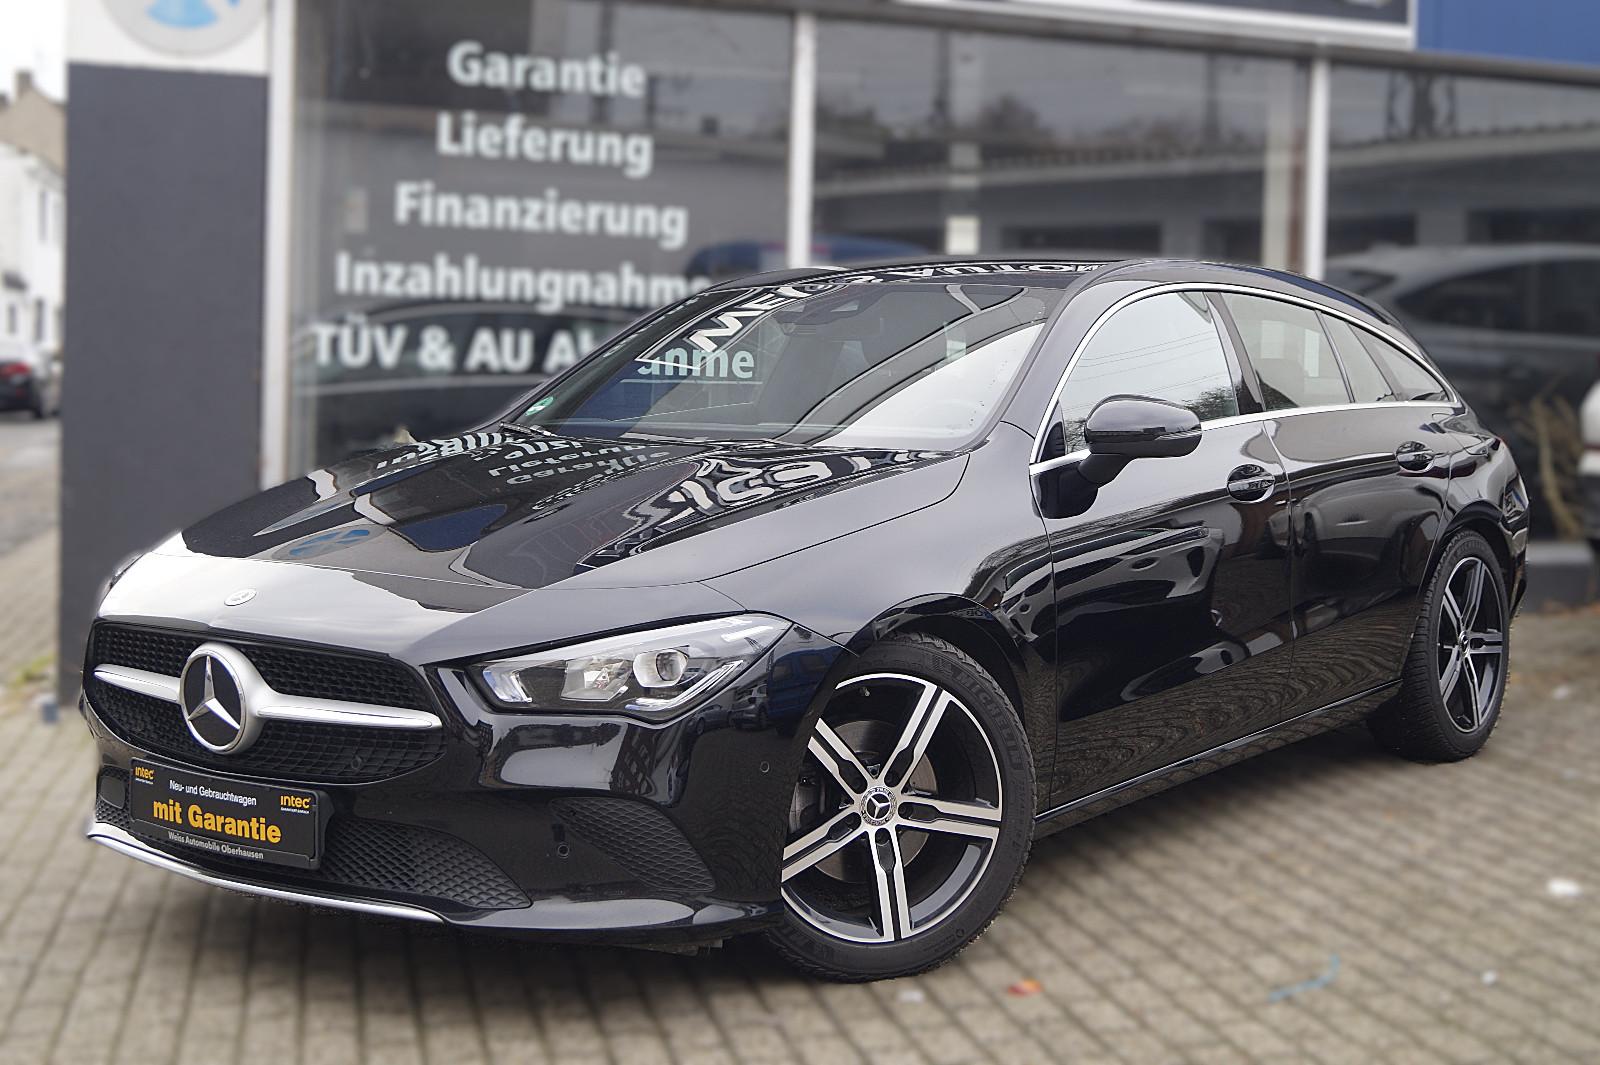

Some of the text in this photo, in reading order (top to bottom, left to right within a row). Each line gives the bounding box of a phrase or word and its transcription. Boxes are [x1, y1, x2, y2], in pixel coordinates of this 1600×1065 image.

[447, 41, 646, 98] Garantie
[436, 113, 654, 178] Lieferung
[395, 181, 689, 250] Finanzierung
[313, 315, 407, 368] TÜV
[417, 325, 454, 371] &
[464, 328, 534, 372] AU
[135, 766, 154, 780] intec
[169, 780, 257, 807] Neu- und Gebrauchtwagen
[153, 799, 282, 843] mit Garantie
[280, 795, 310, 809] intec
[168, 831, 264, 859] Weiss Automobile Oberhausen
